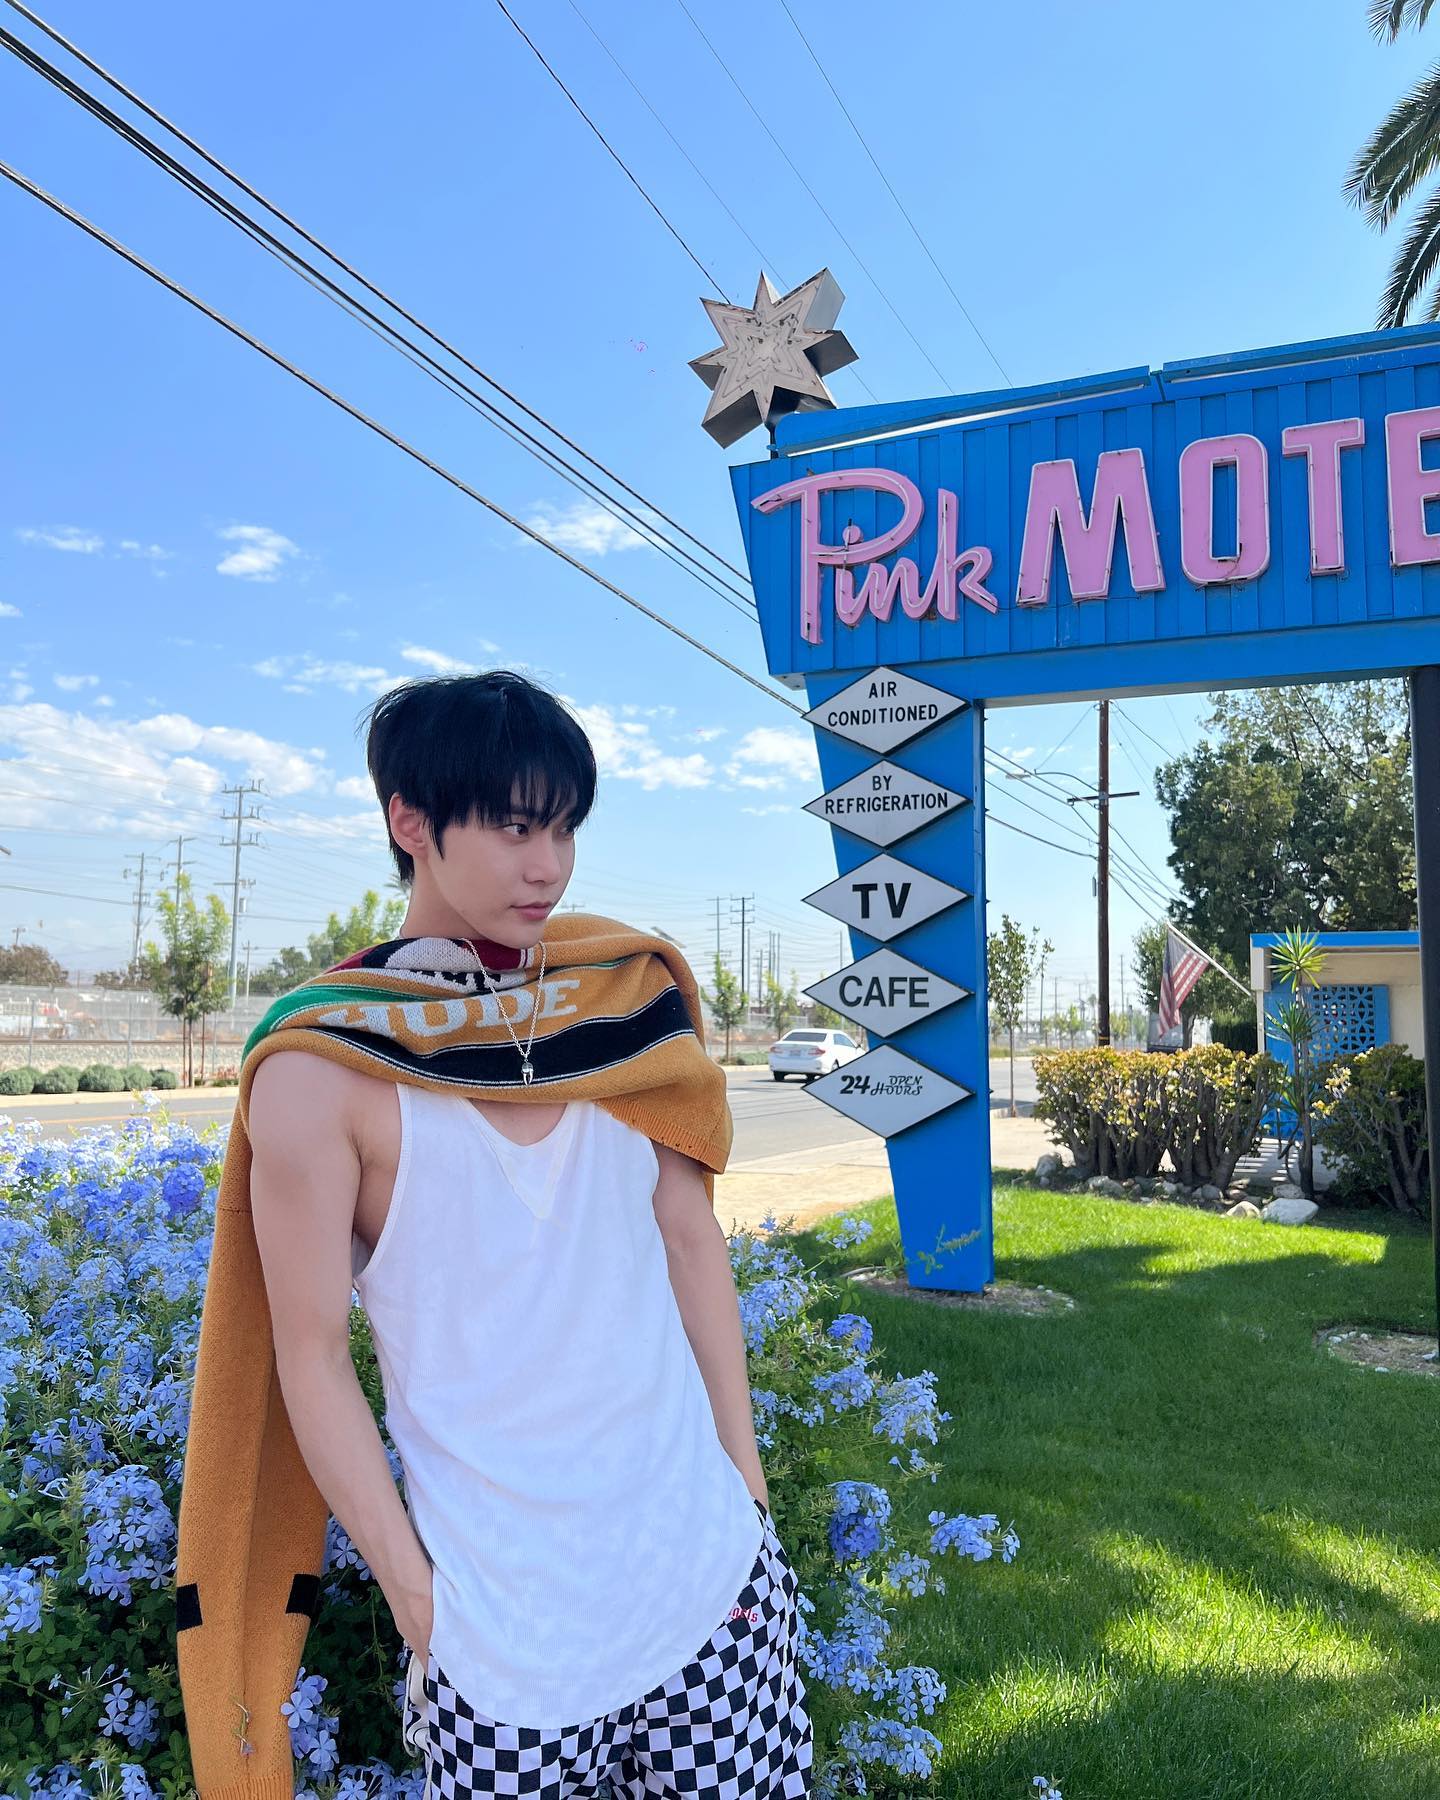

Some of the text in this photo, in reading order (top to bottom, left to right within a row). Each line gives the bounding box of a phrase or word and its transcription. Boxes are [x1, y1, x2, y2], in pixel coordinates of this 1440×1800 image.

[751, 468, 998, 645] Pink
[868, 681, 897, 699] AIR
[828, 704, 938, 727] CONDITIONED
[872, 775, 892, 791] BY
[825, 792, 948, 814] REFRIGERATION
[852, 883, 911, 919] TV
[839, 975, 929, 1008] CAFE
[840, 1075, 923, 1096] 24 HOURS
[889, 1075, 922, 1086] OPEN
